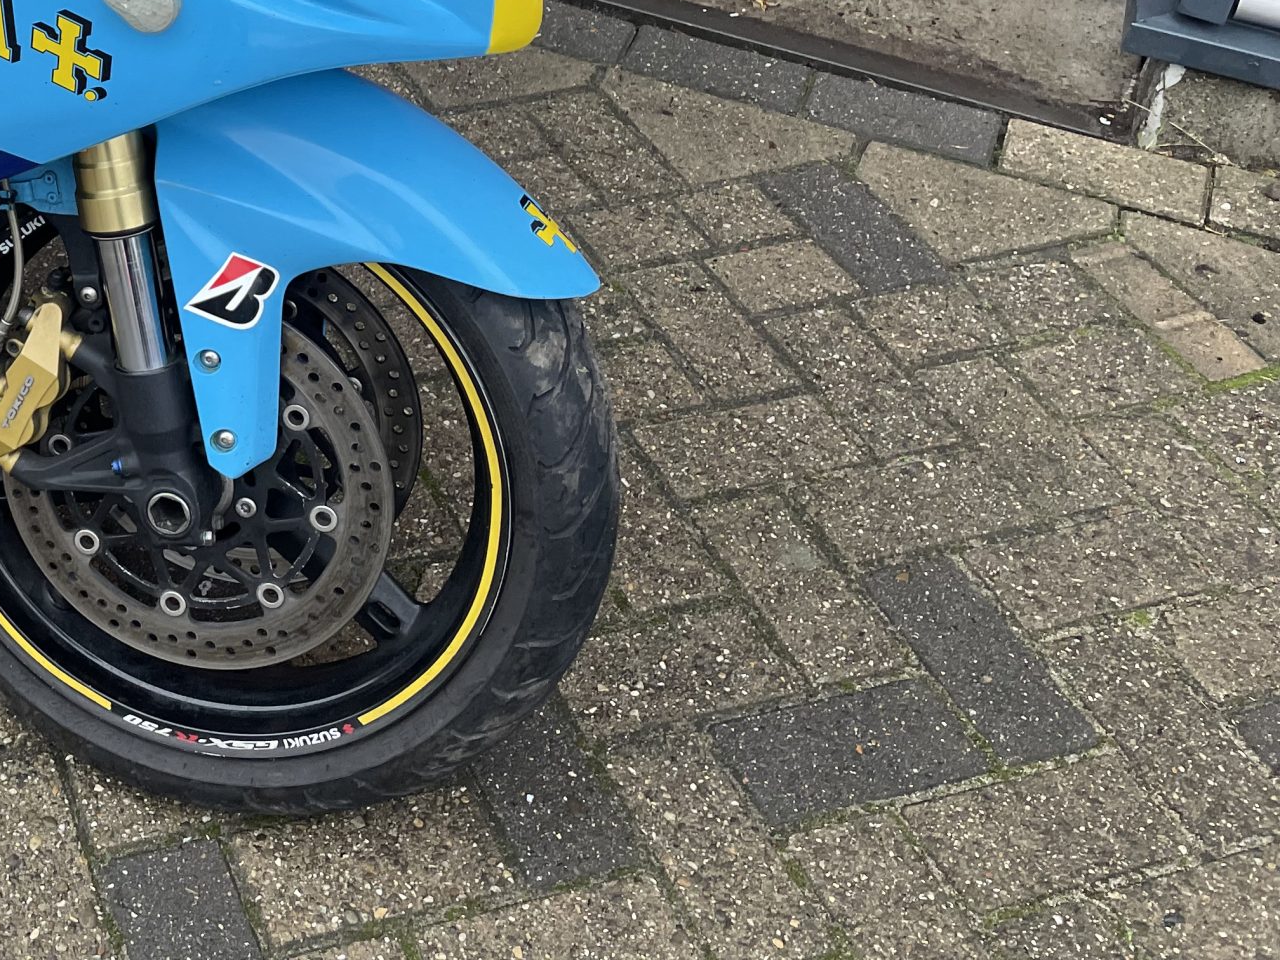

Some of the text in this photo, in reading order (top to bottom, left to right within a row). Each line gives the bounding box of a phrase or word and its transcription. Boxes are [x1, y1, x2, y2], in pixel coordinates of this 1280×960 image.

[1, 375, 35, 429] TOKICO
[122, 714, 173, 738] 750
[283, 727, 341, 750] SUZUKI
